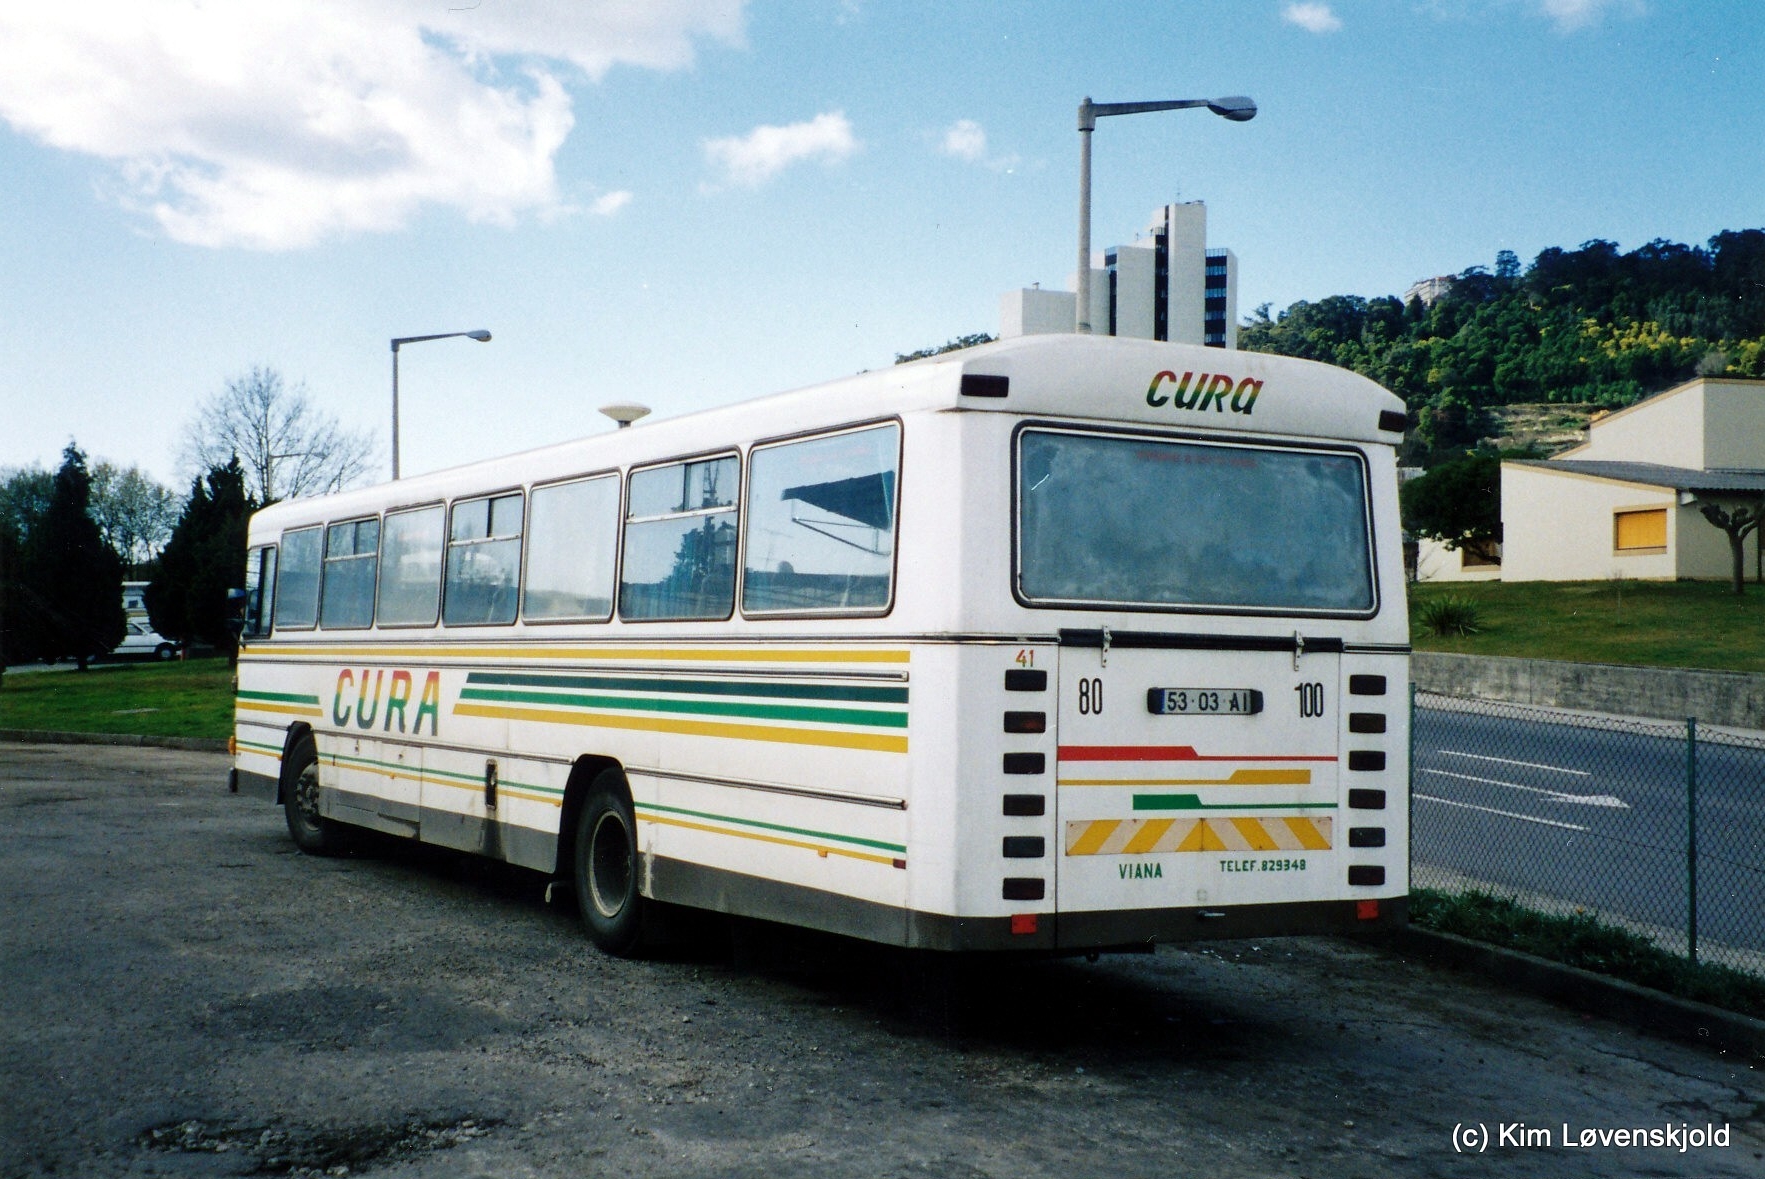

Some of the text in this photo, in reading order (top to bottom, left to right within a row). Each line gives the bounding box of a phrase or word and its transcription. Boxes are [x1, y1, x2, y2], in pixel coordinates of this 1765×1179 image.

[1015, 649, 1035, 668] 41
[333, 668, 440, 737] CURA
[1079, 678, 1103, 715] 80
[1294, 682, 1324, 718] 100
[1119, 863, 1163, 880] VIANA
